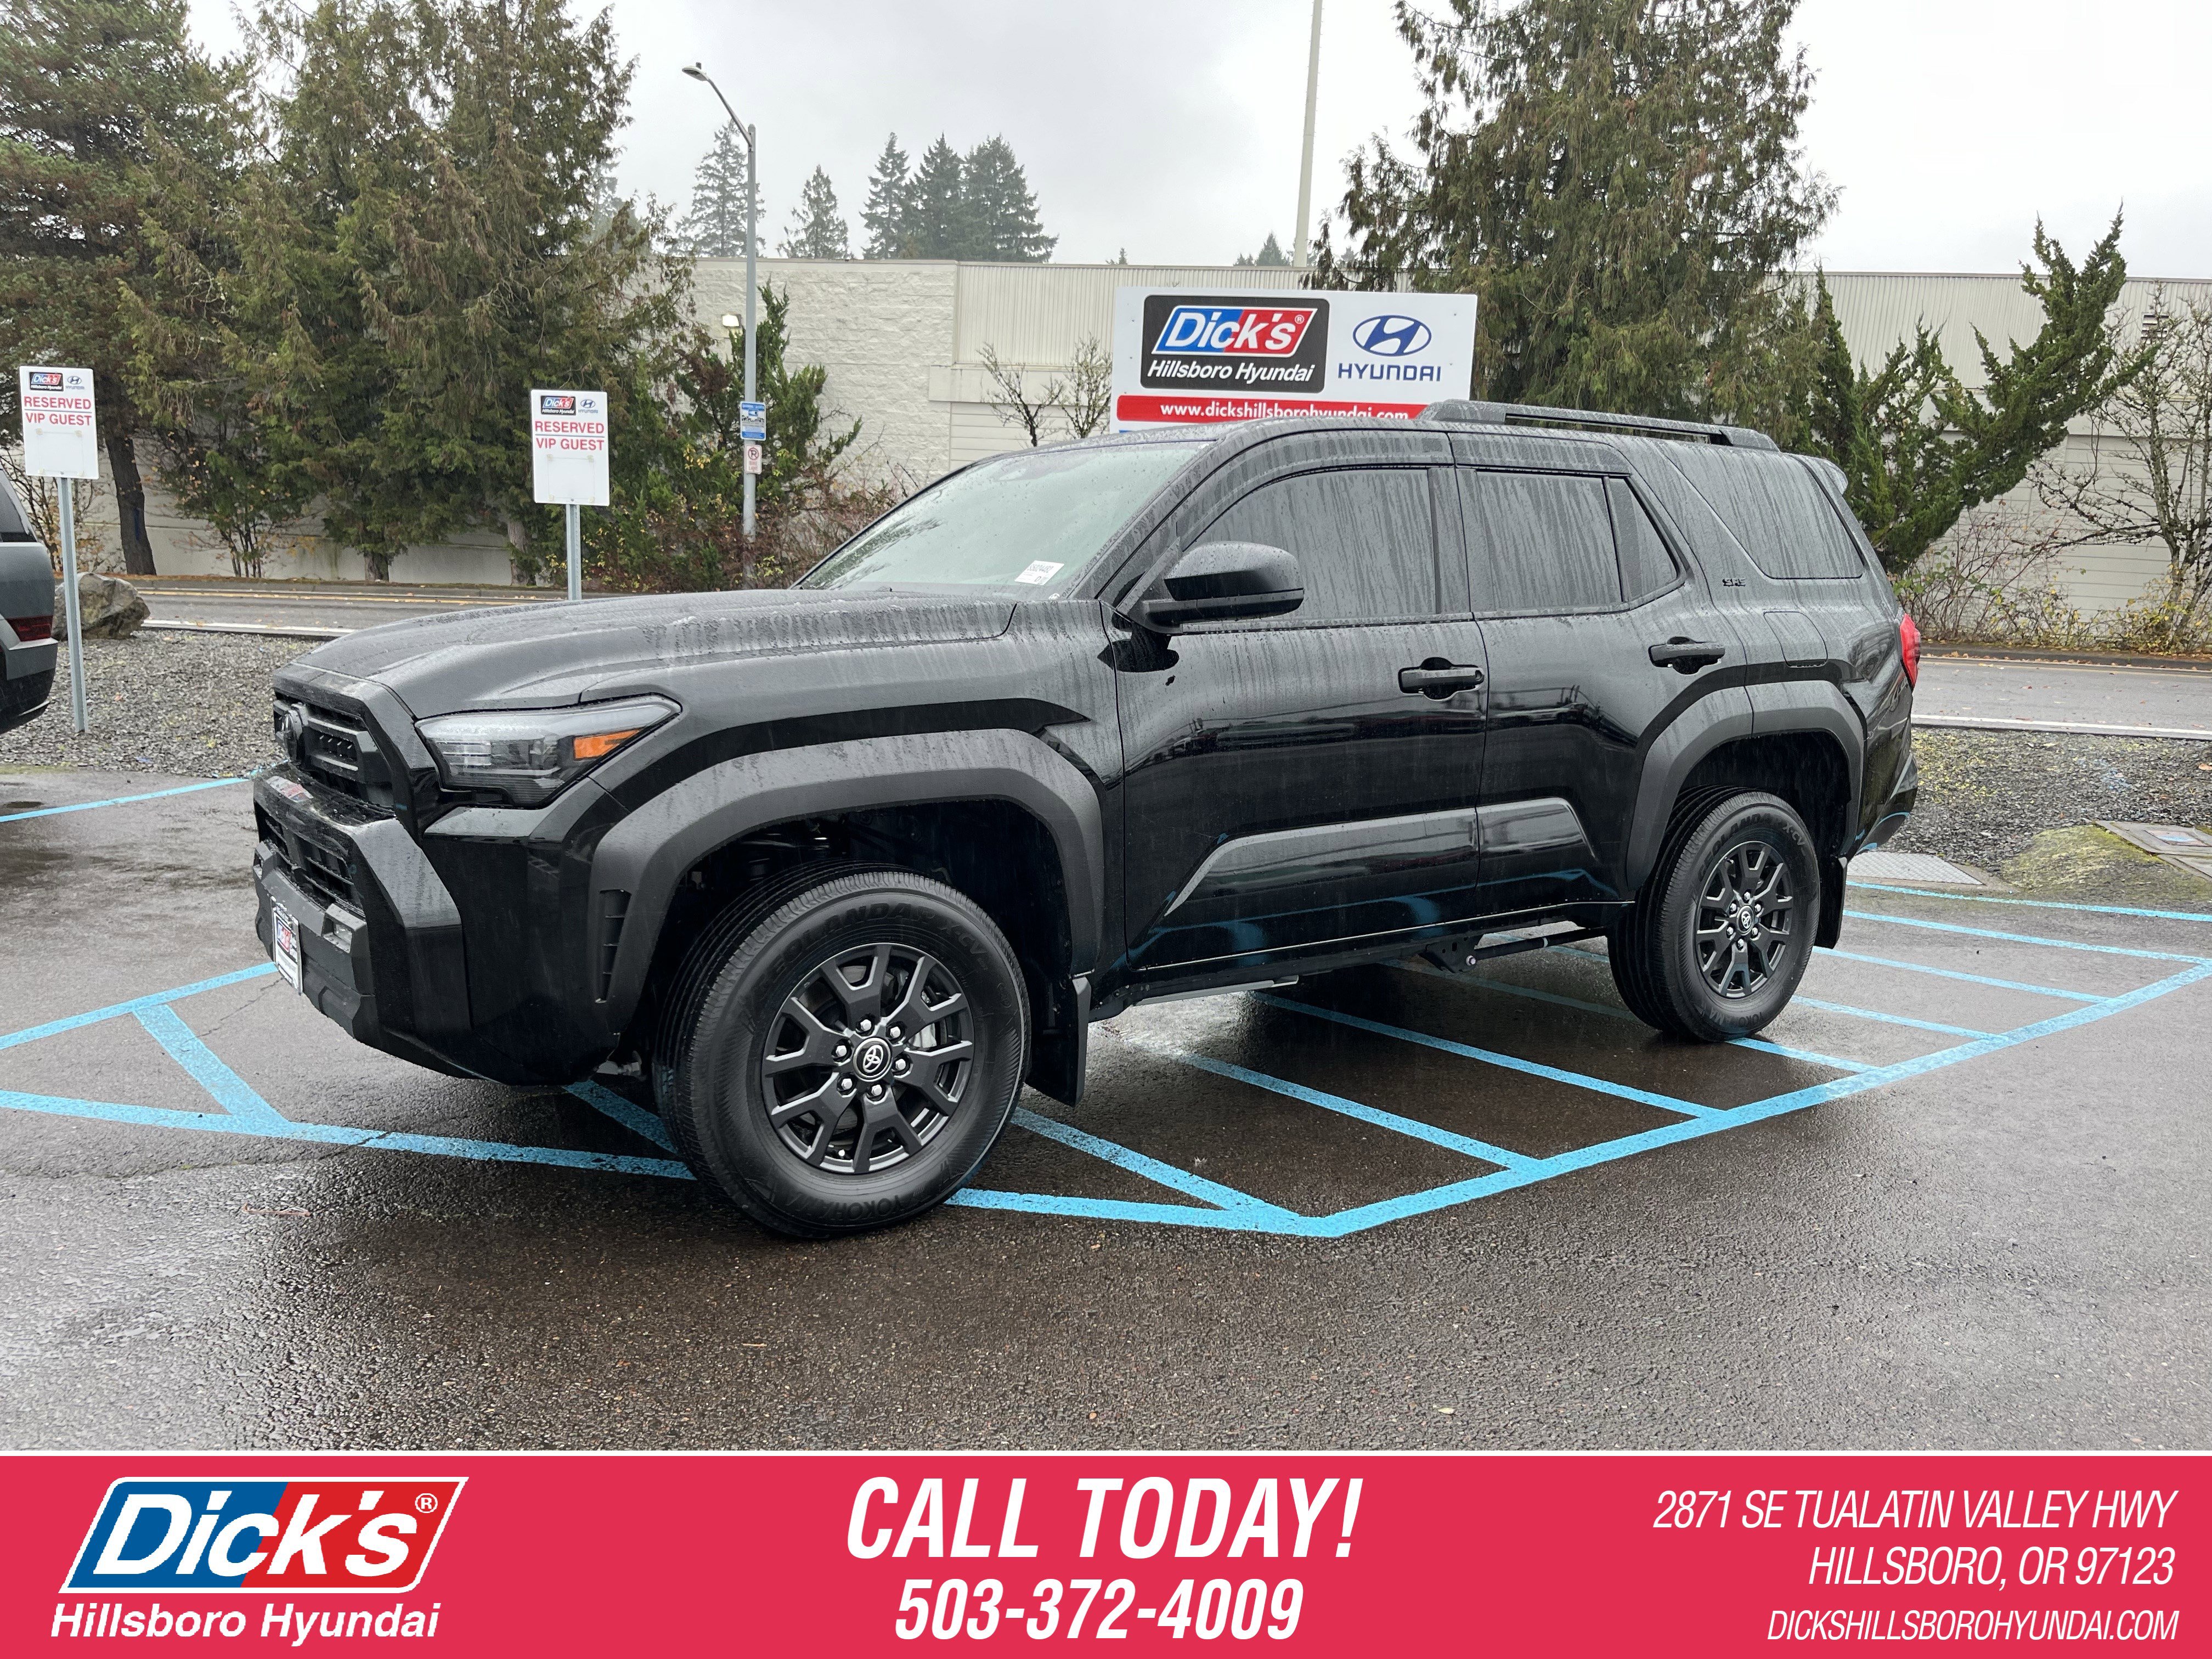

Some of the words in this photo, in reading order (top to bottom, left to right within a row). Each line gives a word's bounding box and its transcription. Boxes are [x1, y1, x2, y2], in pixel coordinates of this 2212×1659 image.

[1166, 312, 1295, 349] Dick's
[1148, 360, 1233, 379] Hillsboro
[1235, 362, 1316, 385] Hyundai
[1338, 363, 1441, 381] HYUNDAI
[24, 396, 92, 409] RESERVED
[1160, 401, 1408, 420] www.dickshillsborohundaicom
[25, 413, 45, 423] VIP
[49, 414, 92, 426] GUEST
[535, 420, 605, 434] RESERVED
[536, 438, 556, 448] VIP
[560, 438, 605, 450] GUEST
